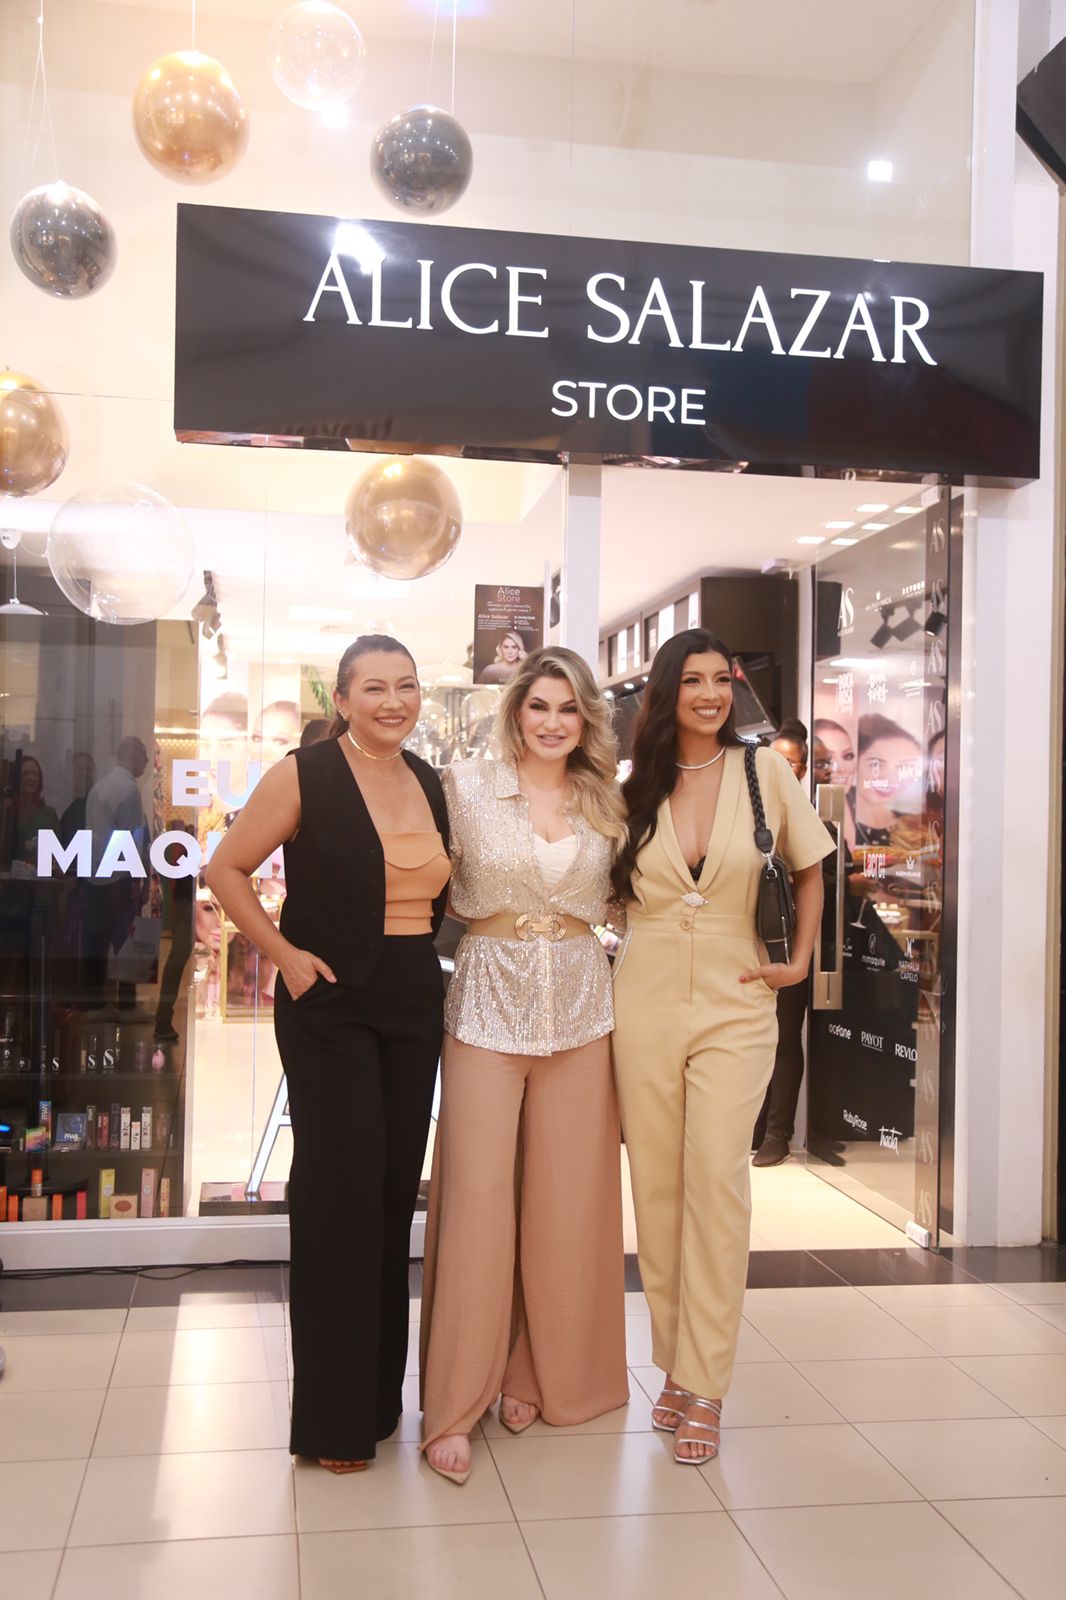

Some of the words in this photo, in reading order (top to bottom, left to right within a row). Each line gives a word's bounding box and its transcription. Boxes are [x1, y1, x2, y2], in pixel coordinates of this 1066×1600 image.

[302, 248, 549, 338] ALICE
[586, 272, 938, 366] SALAZAR
[551, 380, 706, 425] STORE
[497, 586, 521, 596] Alice
[172, 759, 262, 808] EU
[861, 1031, 883, 1049] PAYOT
